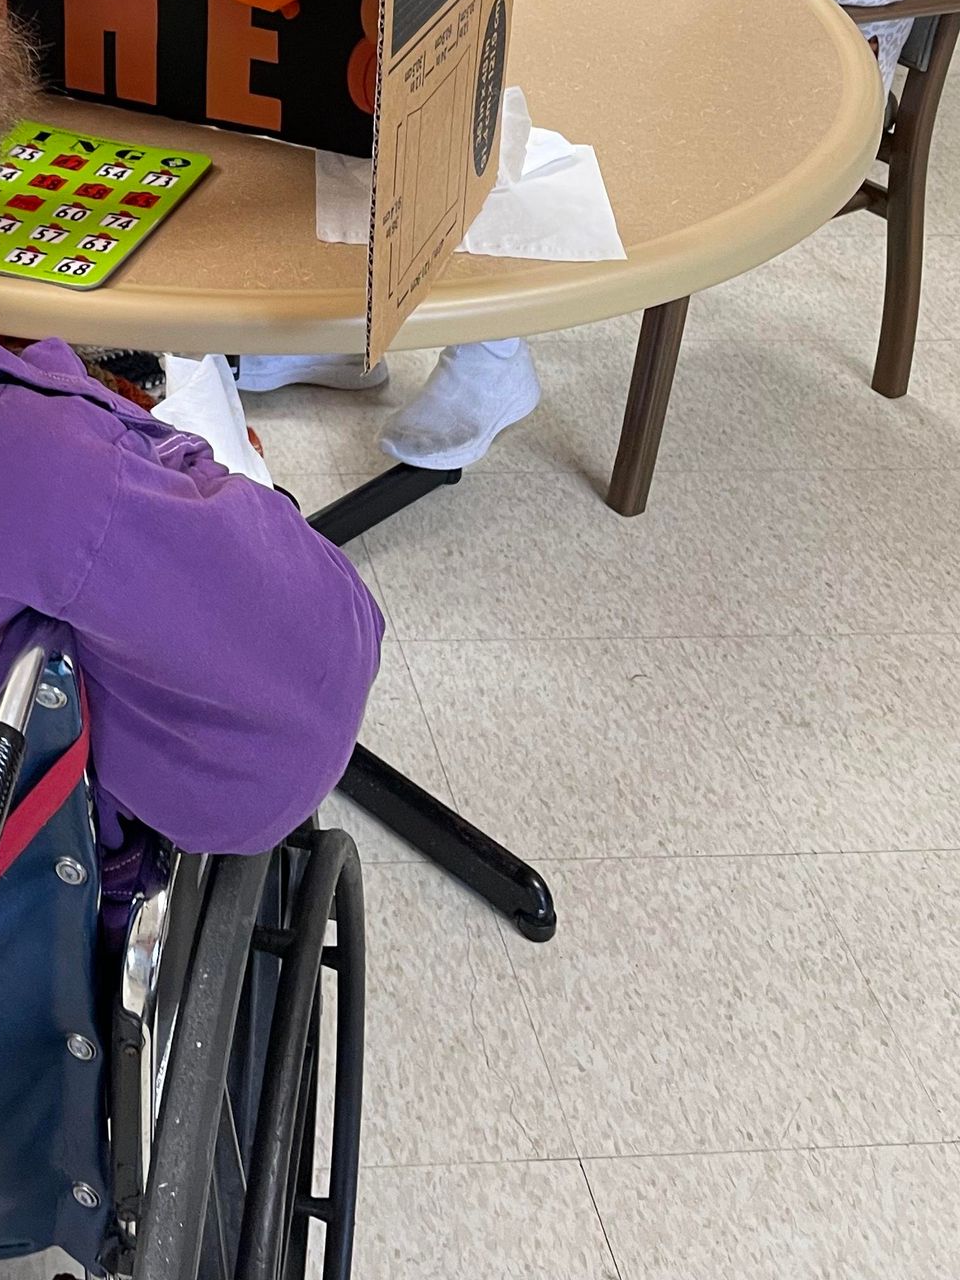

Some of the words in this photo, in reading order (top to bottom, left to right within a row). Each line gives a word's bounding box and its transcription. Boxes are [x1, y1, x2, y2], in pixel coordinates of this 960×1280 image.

[11, 147, 39, 161] 25
[99, 166, 127, 180] 54
[146, 174, 173, 187] 73
[55, 207, 88, 222] 60
[104, 216, 133, 230] 74
[31, 228, 65, 243] 57
[82, 238, 113, 252] 63
[8, 251, 39, 266] 53
[57, 261, 92, 276] 68
